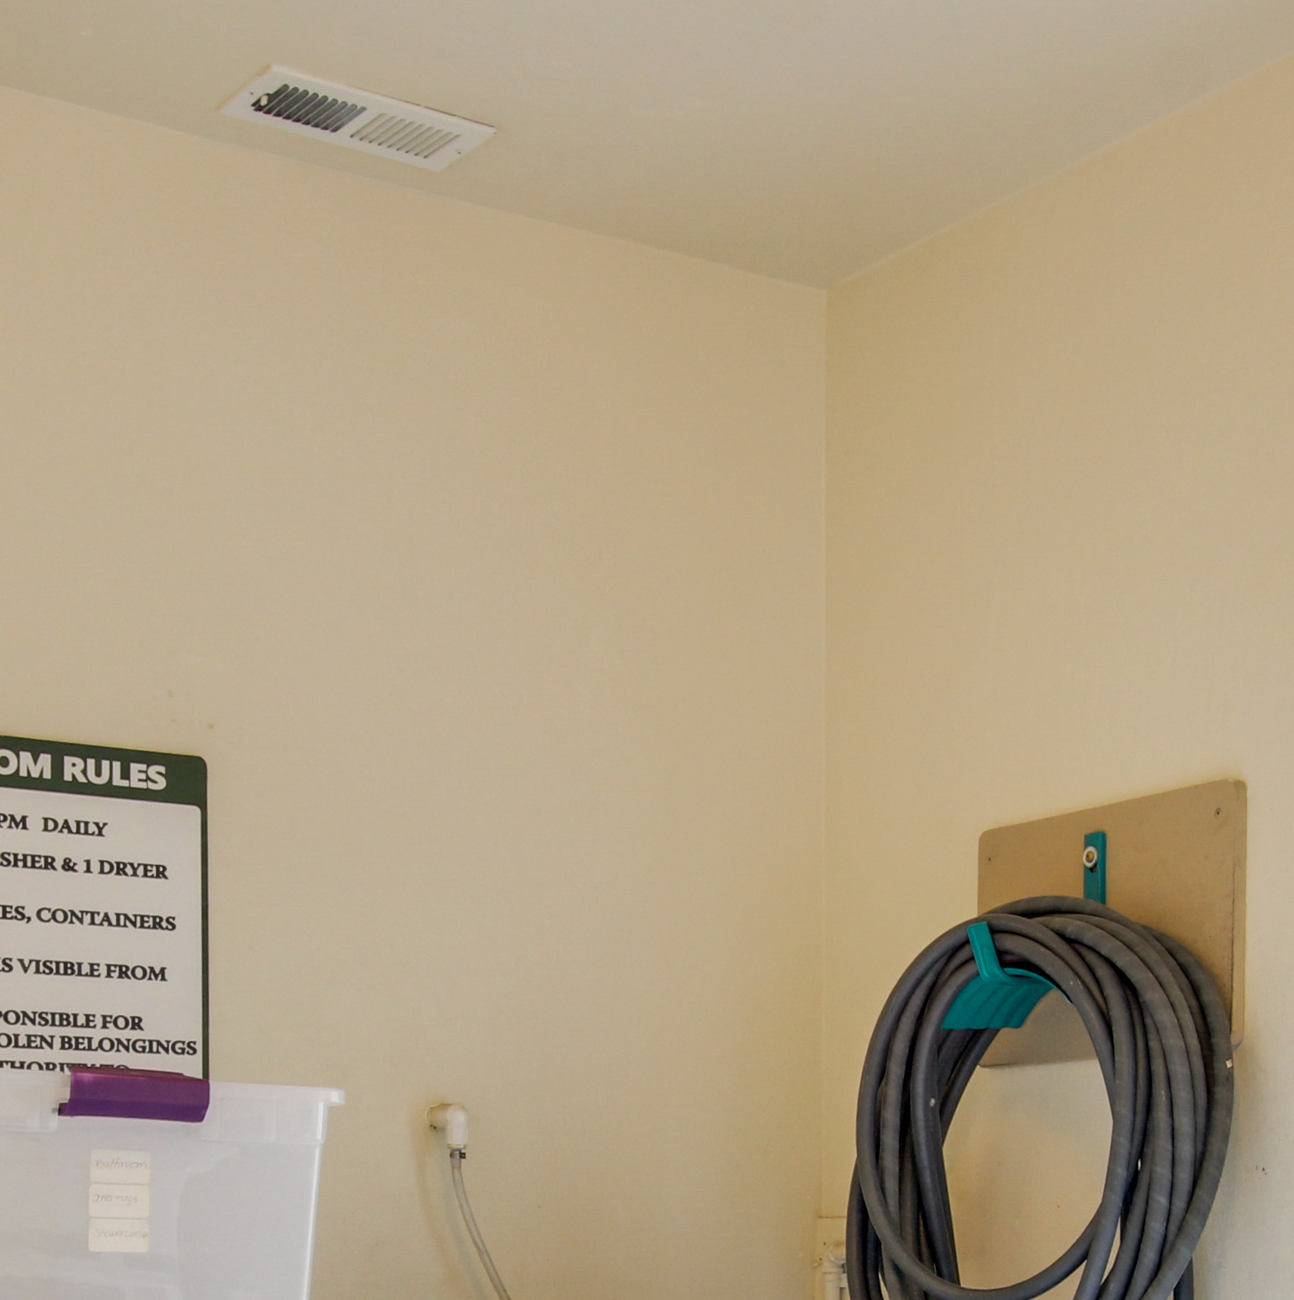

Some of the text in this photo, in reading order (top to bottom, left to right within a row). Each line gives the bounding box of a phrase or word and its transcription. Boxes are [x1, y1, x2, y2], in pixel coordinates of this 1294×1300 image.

[63, 757, 167, 791] RULES
[42, 817, 108, 837] DAILY
[61, 857, 78, 872] &
[83, 858, 93, 874] 1
[98, 860, 168, 879] DRYER
[36, 907, 176, 931] CONTAINERS
[17, 958, 99, 978] VISIBLE
[104, 964, 167, 982] FROM
[101, 1014, 144, 1031] FOR
[60, 1036, 197, 1056] BELONGINGS
